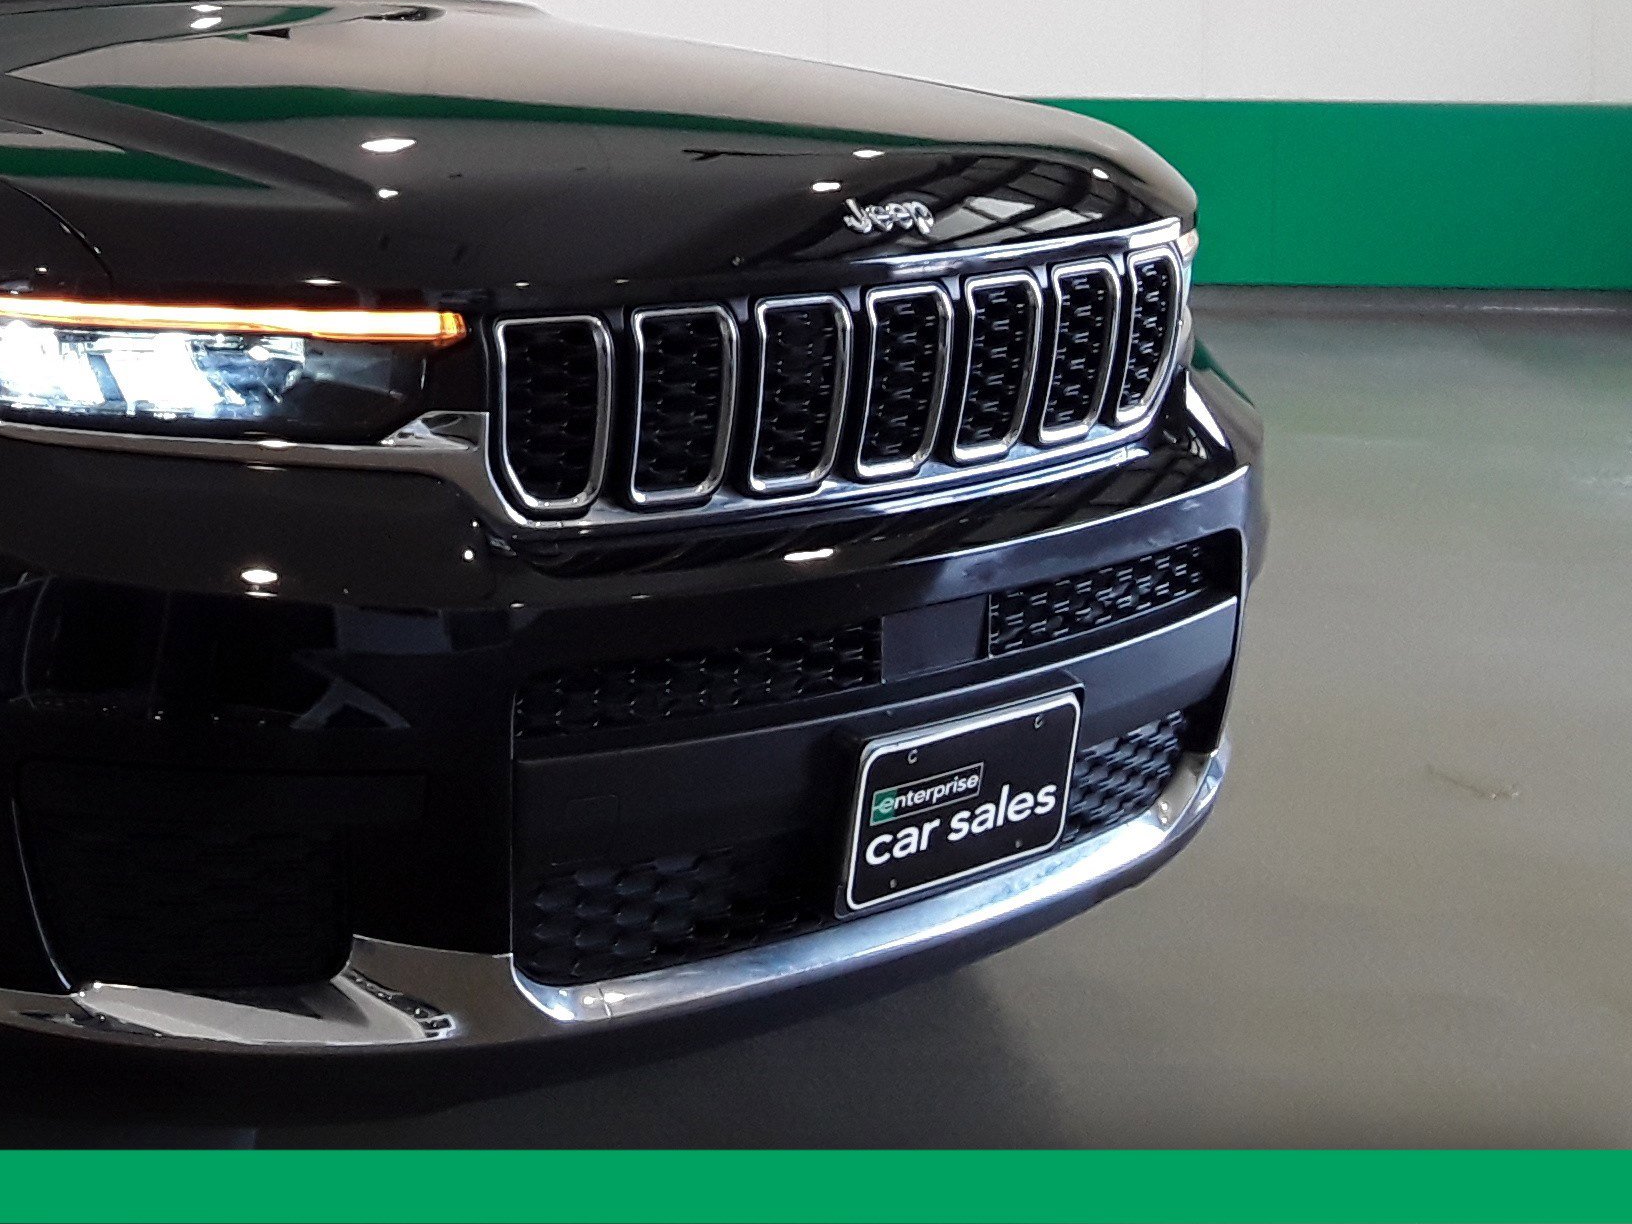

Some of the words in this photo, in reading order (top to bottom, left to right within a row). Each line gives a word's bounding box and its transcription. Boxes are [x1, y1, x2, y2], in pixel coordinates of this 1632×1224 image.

[843, 197, 935, 235] Jeep
[876, 774, 980, 815] enterprise
[865, 817, 942, 866] car
[946, 783, 1058, 842] sales
